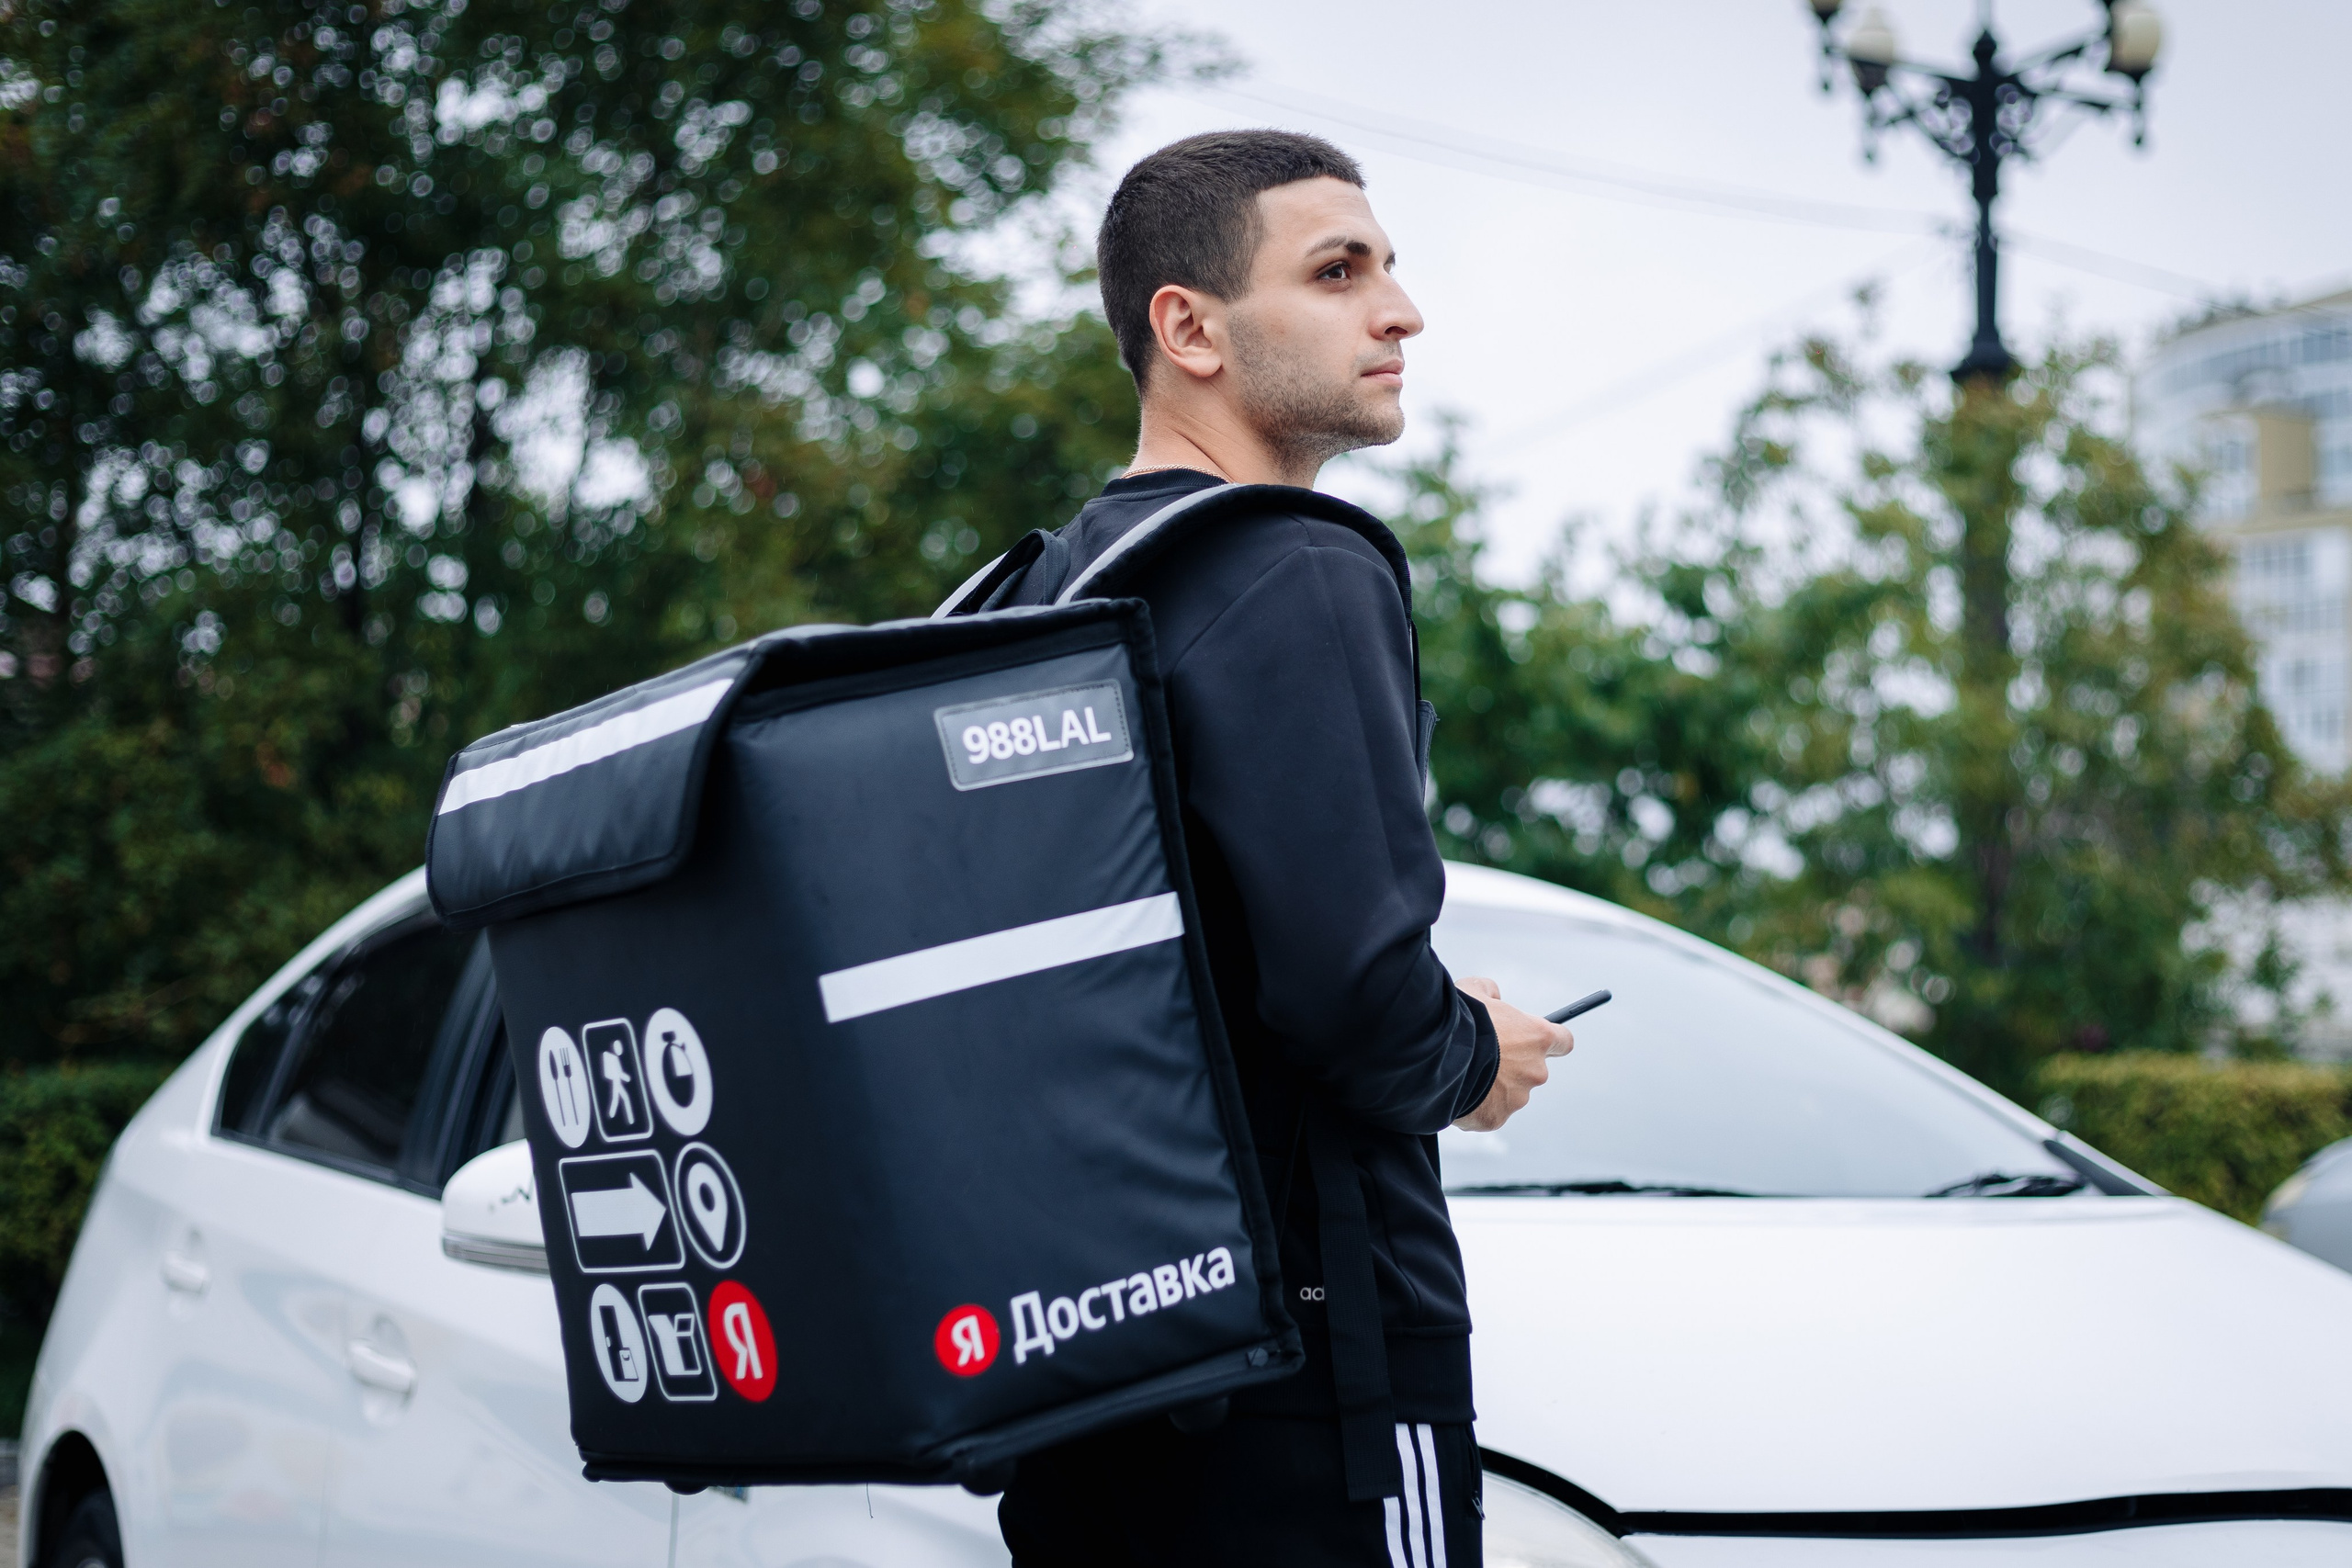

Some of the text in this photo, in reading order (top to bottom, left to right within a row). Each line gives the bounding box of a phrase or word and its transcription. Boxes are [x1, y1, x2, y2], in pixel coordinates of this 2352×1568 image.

[962, 705, 1112, 764] 988LAL
[723, 1302, 763, 1380] Я
[950, 1246, 1236, 1367] Я Доставка
